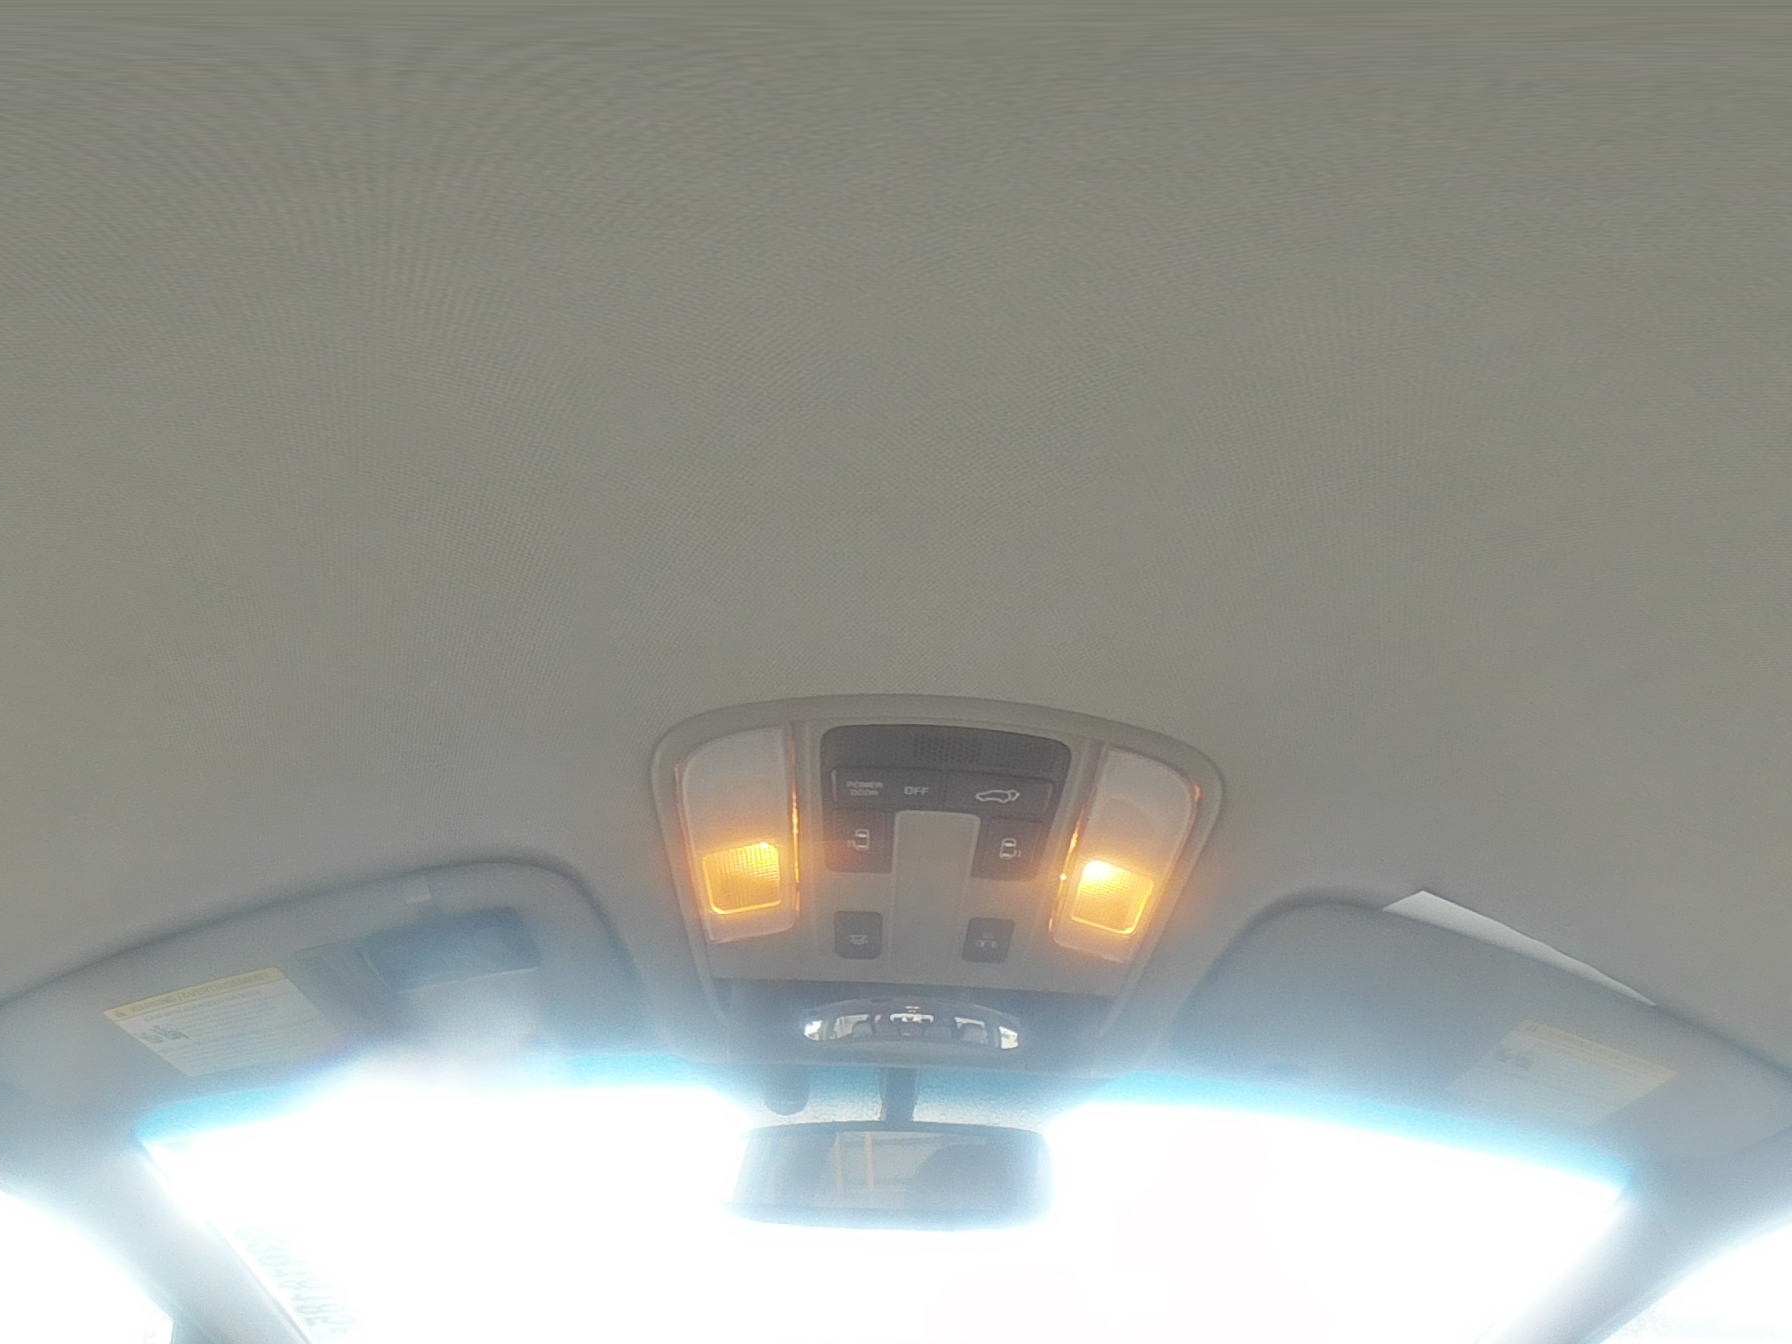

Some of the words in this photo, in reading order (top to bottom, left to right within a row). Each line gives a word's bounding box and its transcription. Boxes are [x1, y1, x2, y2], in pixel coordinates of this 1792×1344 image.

[845, 780, 883, 789] POWER
[849, 789, 878, 797] DOOR
[903, 786, 930, 796] OFF
